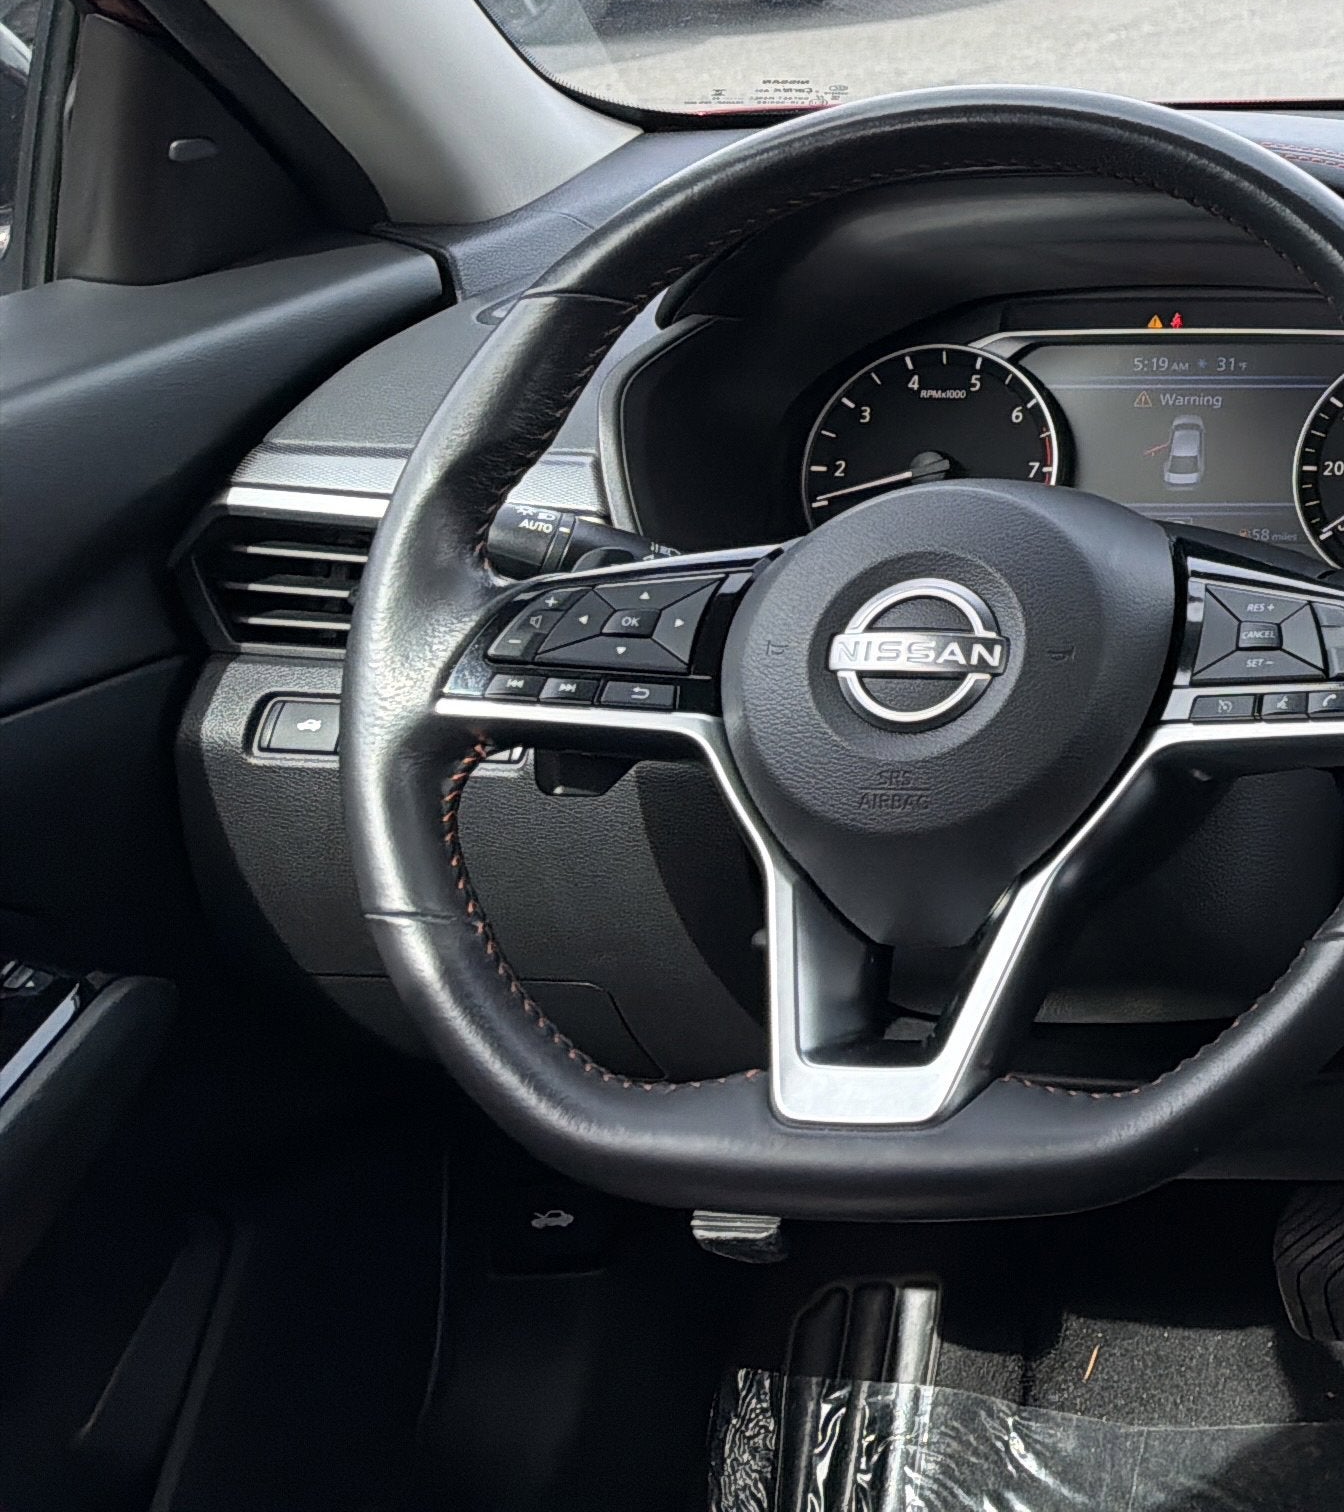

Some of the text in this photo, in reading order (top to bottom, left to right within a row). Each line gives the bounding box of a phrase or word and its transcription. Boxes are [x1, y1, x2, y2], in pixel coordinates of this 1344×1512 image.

[1133, 357, 1169, 371] 5:19
[1170, 362, 1189, 371] AM
[1216, 357, 1235, 372] 31
[907, 375, 920, 390] 4
[969, 374, 981, 391] 5
[1159, 393, 1222, 408] Warning
[859, 407, 871, 423] 3
[1011, 407, 1023, 423] 6
[834, 461, 846, 477] 2
[1028, 462, 1040, 478] 7
[1323, 461, 1344, 476] 20
[519, 518, 553, 534] AUTO
[1271, 532, 1298, 541] miles
[1246, 603, 1265, 612] RES
[621, 616, 640, 627] OK
[1241, 630, 1276, 639] CANCEL
[838, 641, 1002, 667] NISSAN
[1246, 658, 1265, 668] SET
[876, 770, 913, 786] SRS
